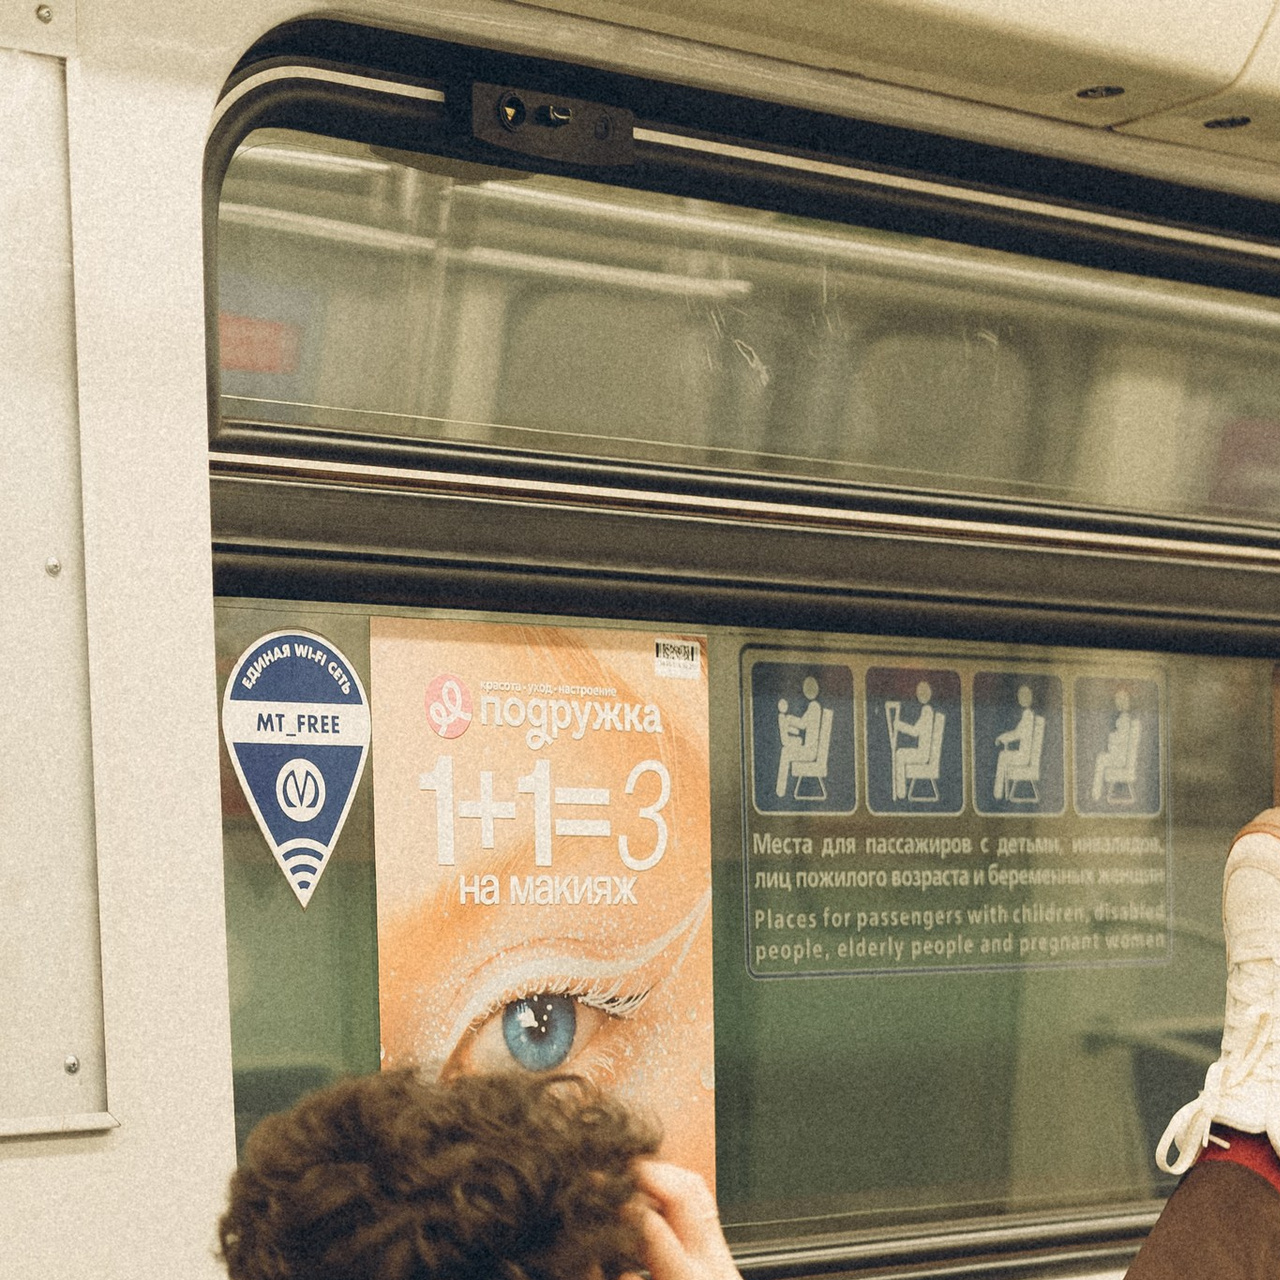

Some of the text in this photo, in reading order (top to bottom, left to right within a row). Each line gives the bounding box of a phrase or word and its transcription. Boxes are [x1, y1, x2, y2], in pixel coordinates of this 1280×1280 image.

[241, 643, 352, 695] ЕДИНАЯ WI-FI СЕТЬ
[480, 680, 617, 698] красота уход настроение
[256, 713, 340, 737] MT_FREE
[480, 694, 664, 751] подружка
[419, 755, 671, 872] 1+1=3
[753, 832, 813, 855] Места
[821, 837, 856, 858] для
[866, 837, 973, 860] пассажиров
[980, 837, 989, 854] с
[997, 837, 1062, 857] детьми,
[459, 874, 638, 906] на макияж
[754, 871, 792, 892] лиц
[796, 870, 887, 888] пожилого
[891, 869, 969, 892] возраста
[973, 869, 984, 886] и
[988, 863, 1094, 891] беременных
[755, 902, 1165, 932] Places for passengers with children, disabled
[756, 932, 1165, 966] people, elderly people and pregnant women
